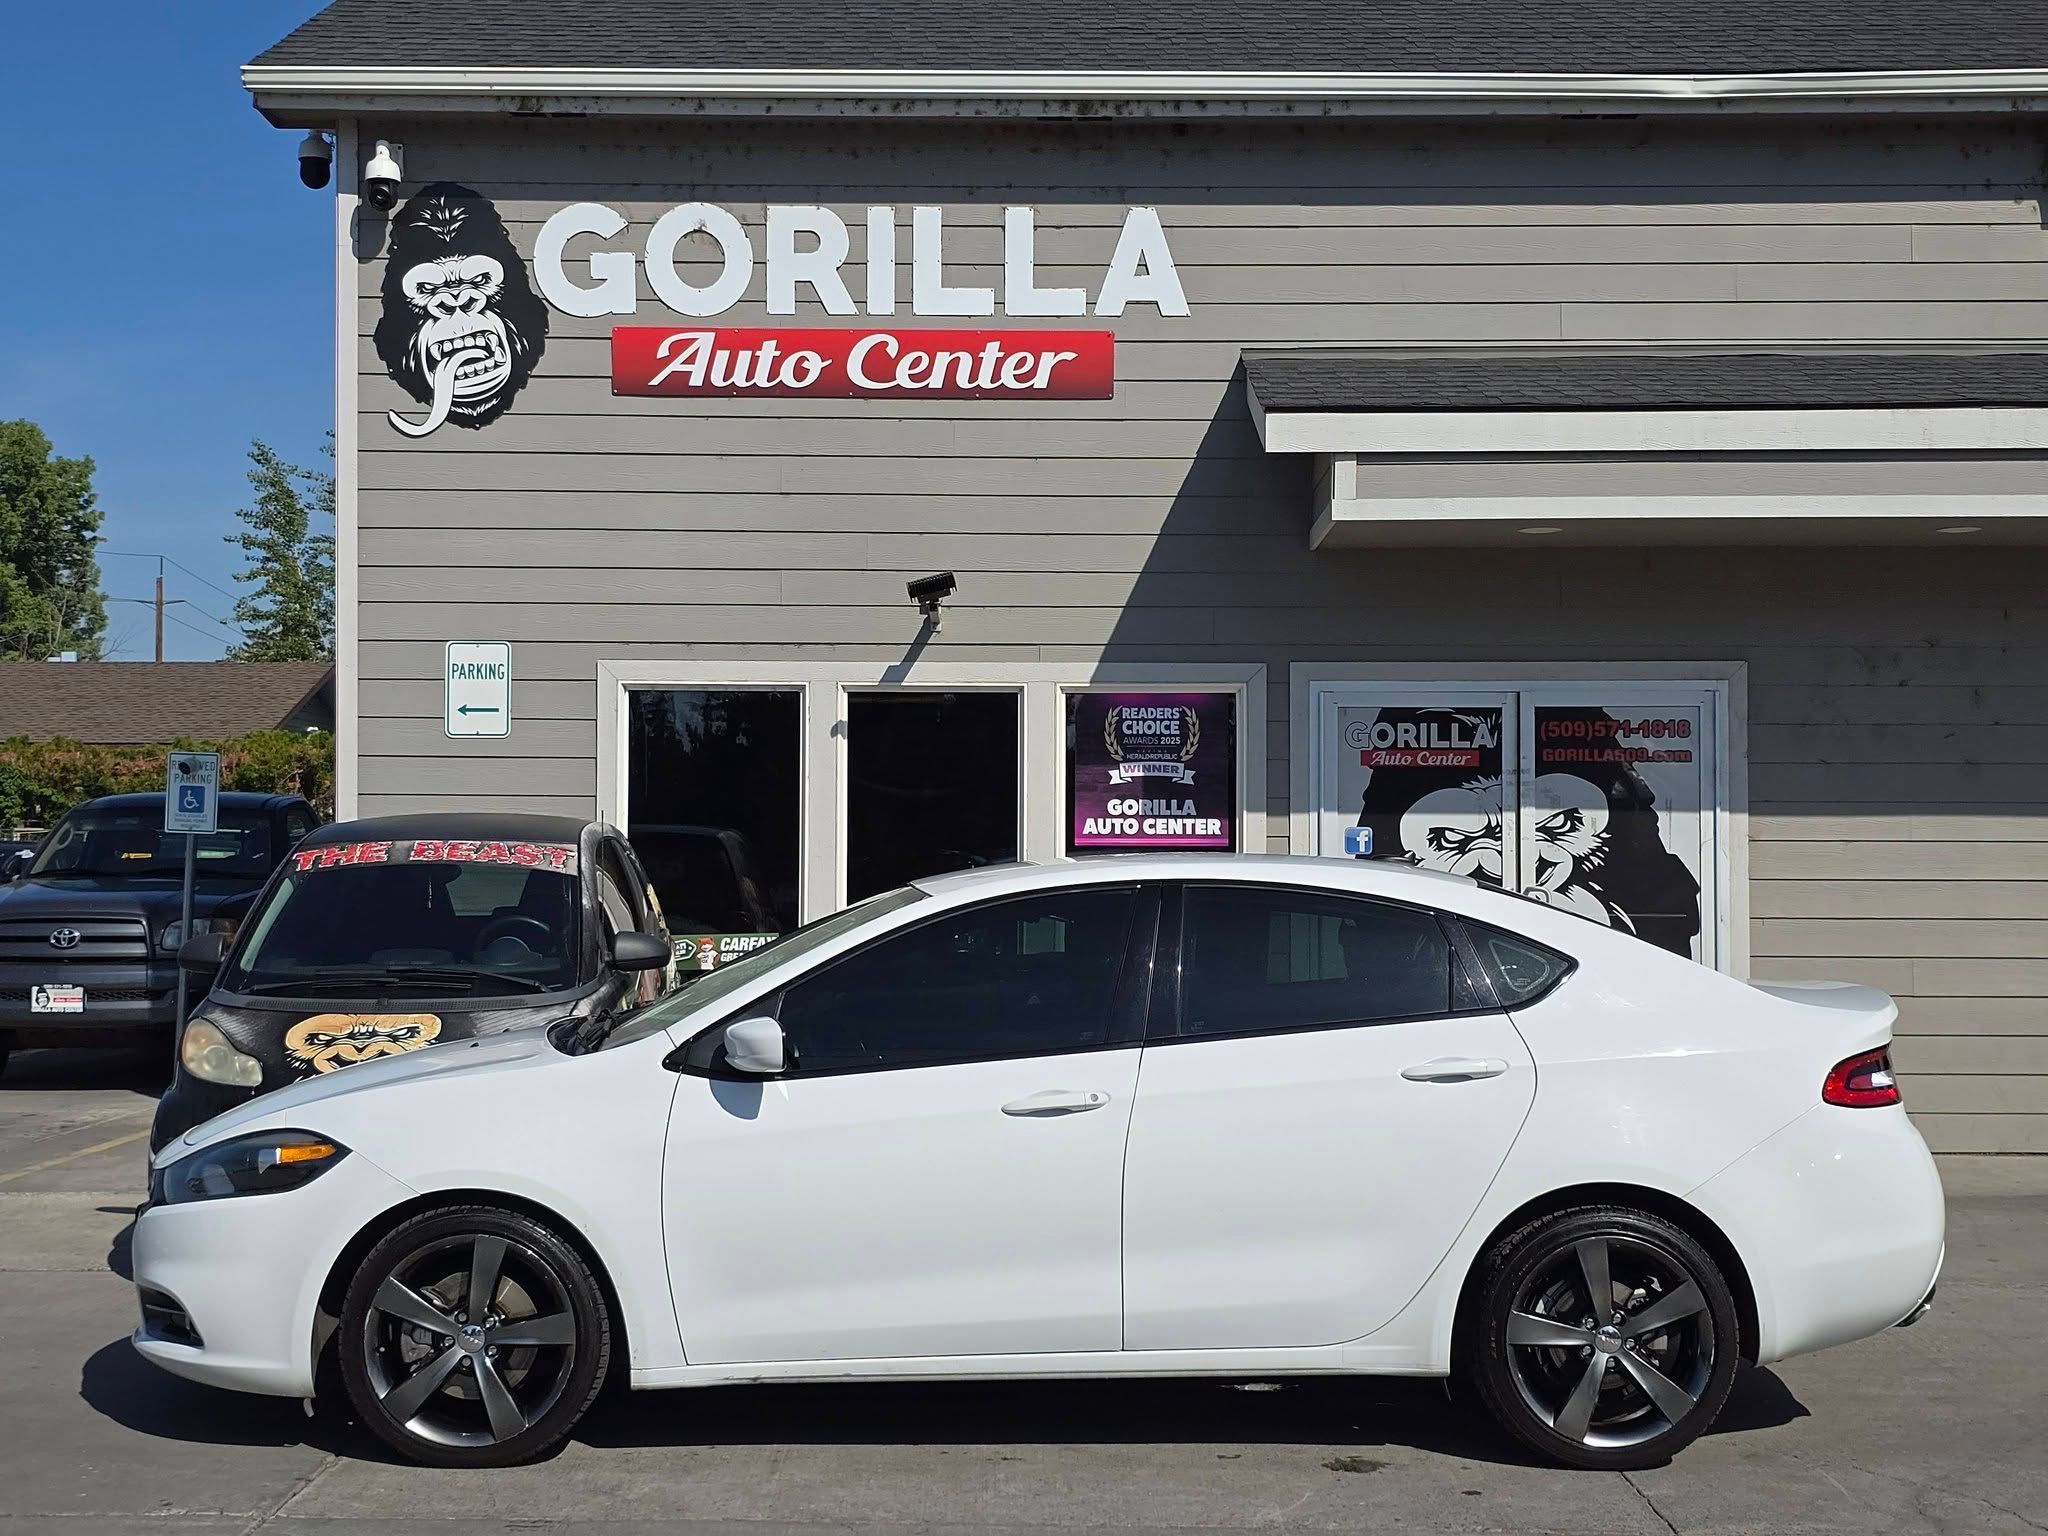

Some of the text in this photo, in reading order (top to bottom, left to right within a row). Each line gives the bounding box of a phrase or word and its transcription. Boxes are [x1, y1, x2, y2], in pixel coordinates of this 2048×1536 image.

[533, 201, 1192, 318] GORILLA
[646, 330, 1079, 392] Auto Center
[451, 663, 505, 680] PARKING
[1122, 707, 1183, 719] READERS'
[1122, 720, 1180, 735] CHOICE
[1344, 721, 1495, 749] GORILLA
[1123, 736, 1181, 745] AWARDS 2025
[1370, 751, 1472, 766] Auto Center
[1122, 764, 1180, 774] WINNER
[174, 773, 212, 784] PARKING
[1107, 799, 1197, 816] GORILLA
[1082, 818, 1222, 835] AUTO CENTER
[292, 840, 578, 872] THE BEAST
